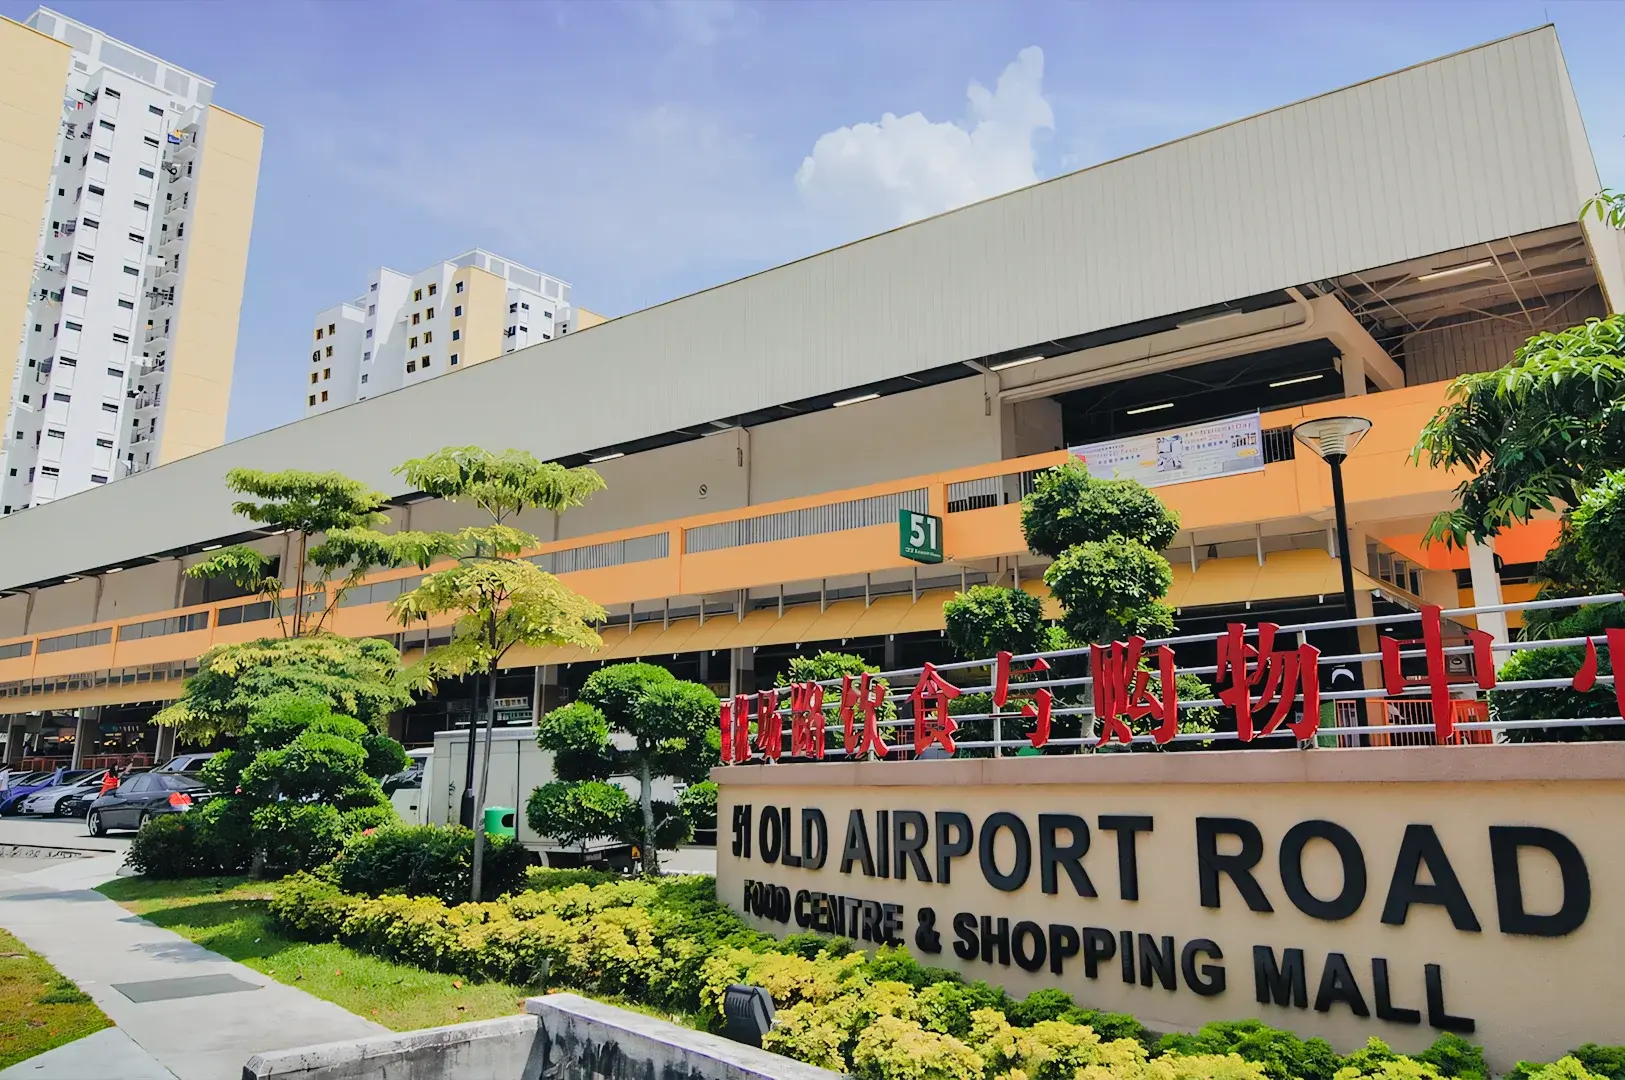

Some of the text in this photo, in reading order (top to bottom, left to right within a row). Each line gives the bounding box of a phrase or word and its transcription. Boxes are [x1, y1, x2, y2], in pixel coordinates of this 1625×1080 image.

[909, 513, 937, 550] 51
[732, 804, 1591, 937] 51 OLD AIRPORT ROAD
[744, 879, 1476, 1033] FOOD CENTRE & SHOPPING MALL
